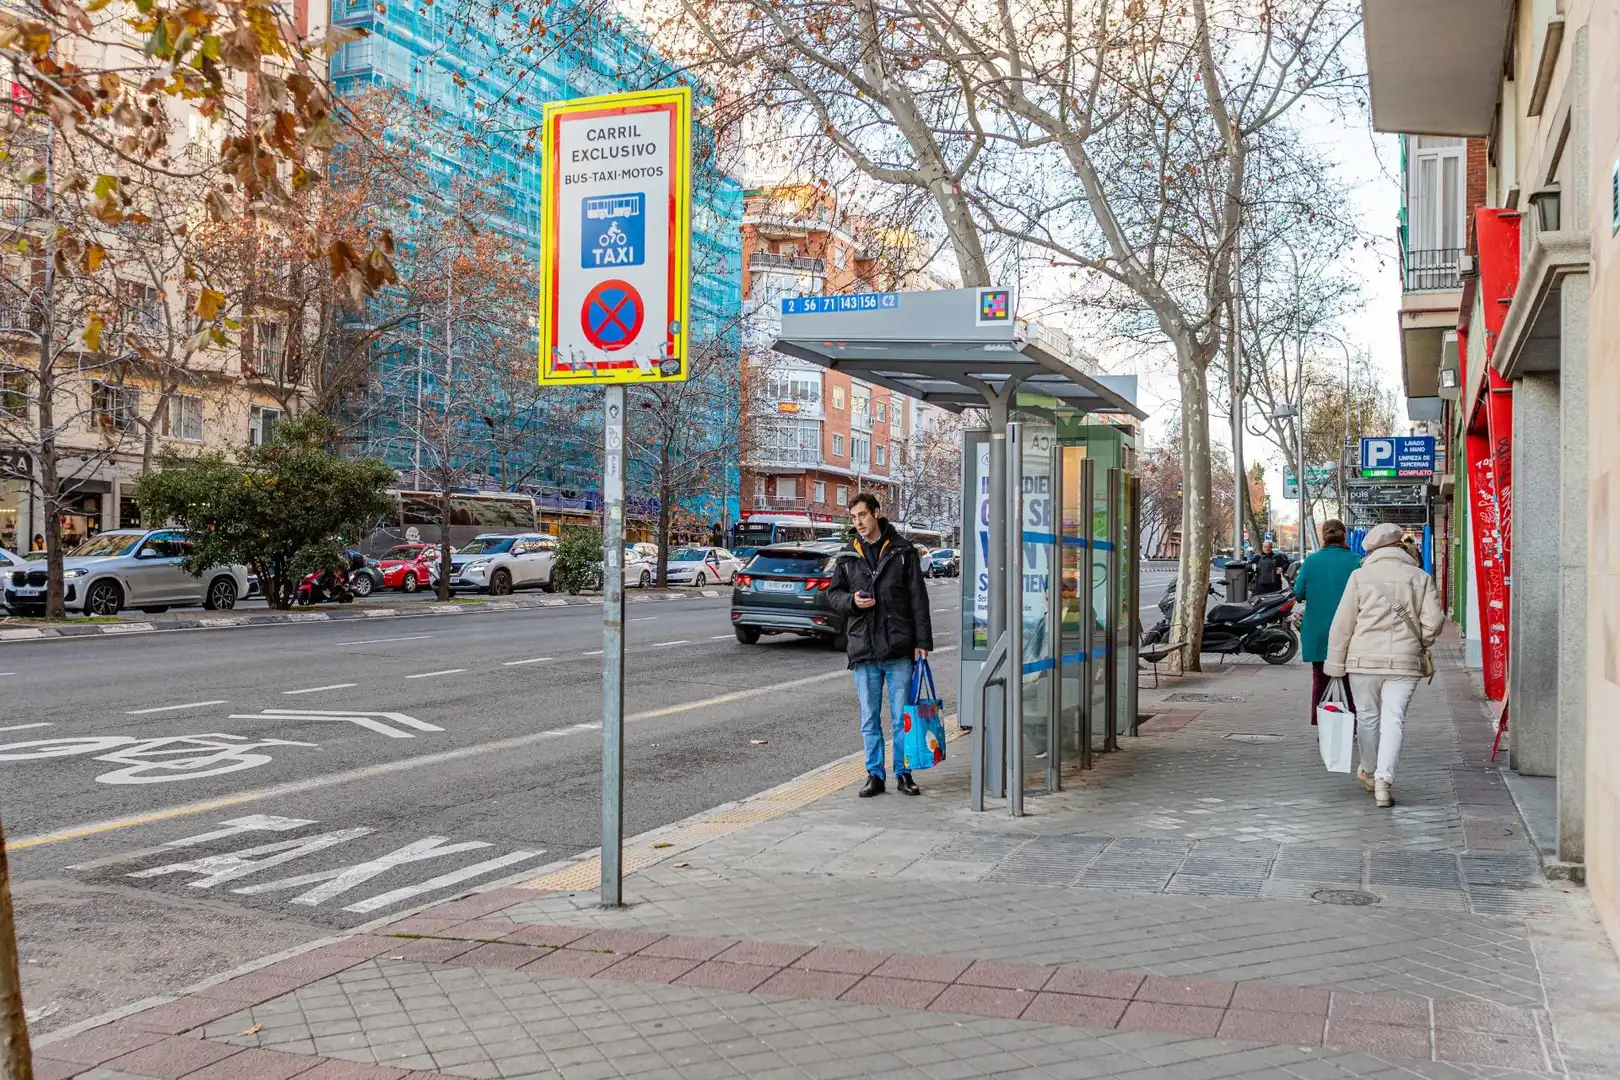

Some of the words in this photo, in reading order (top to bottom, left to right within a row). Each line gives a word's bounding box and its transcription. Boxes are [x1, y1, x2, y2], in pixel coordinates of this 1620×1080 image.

[587, 125, 641, 141] CARRIL
[572, 142, 657, 162] EXCLUSIVO
[592, 246, 634, 265] TAXI
[788, 300, 795, 312] 2
[804, 299, 816, 311] 56
[823, 298, 835, 310] 71
[841, 297, 857, 309] 143
[860, 295, 876, 308] 156
[882, 295, 895, 307] C2
[1368, 440, 1392, 467] P
